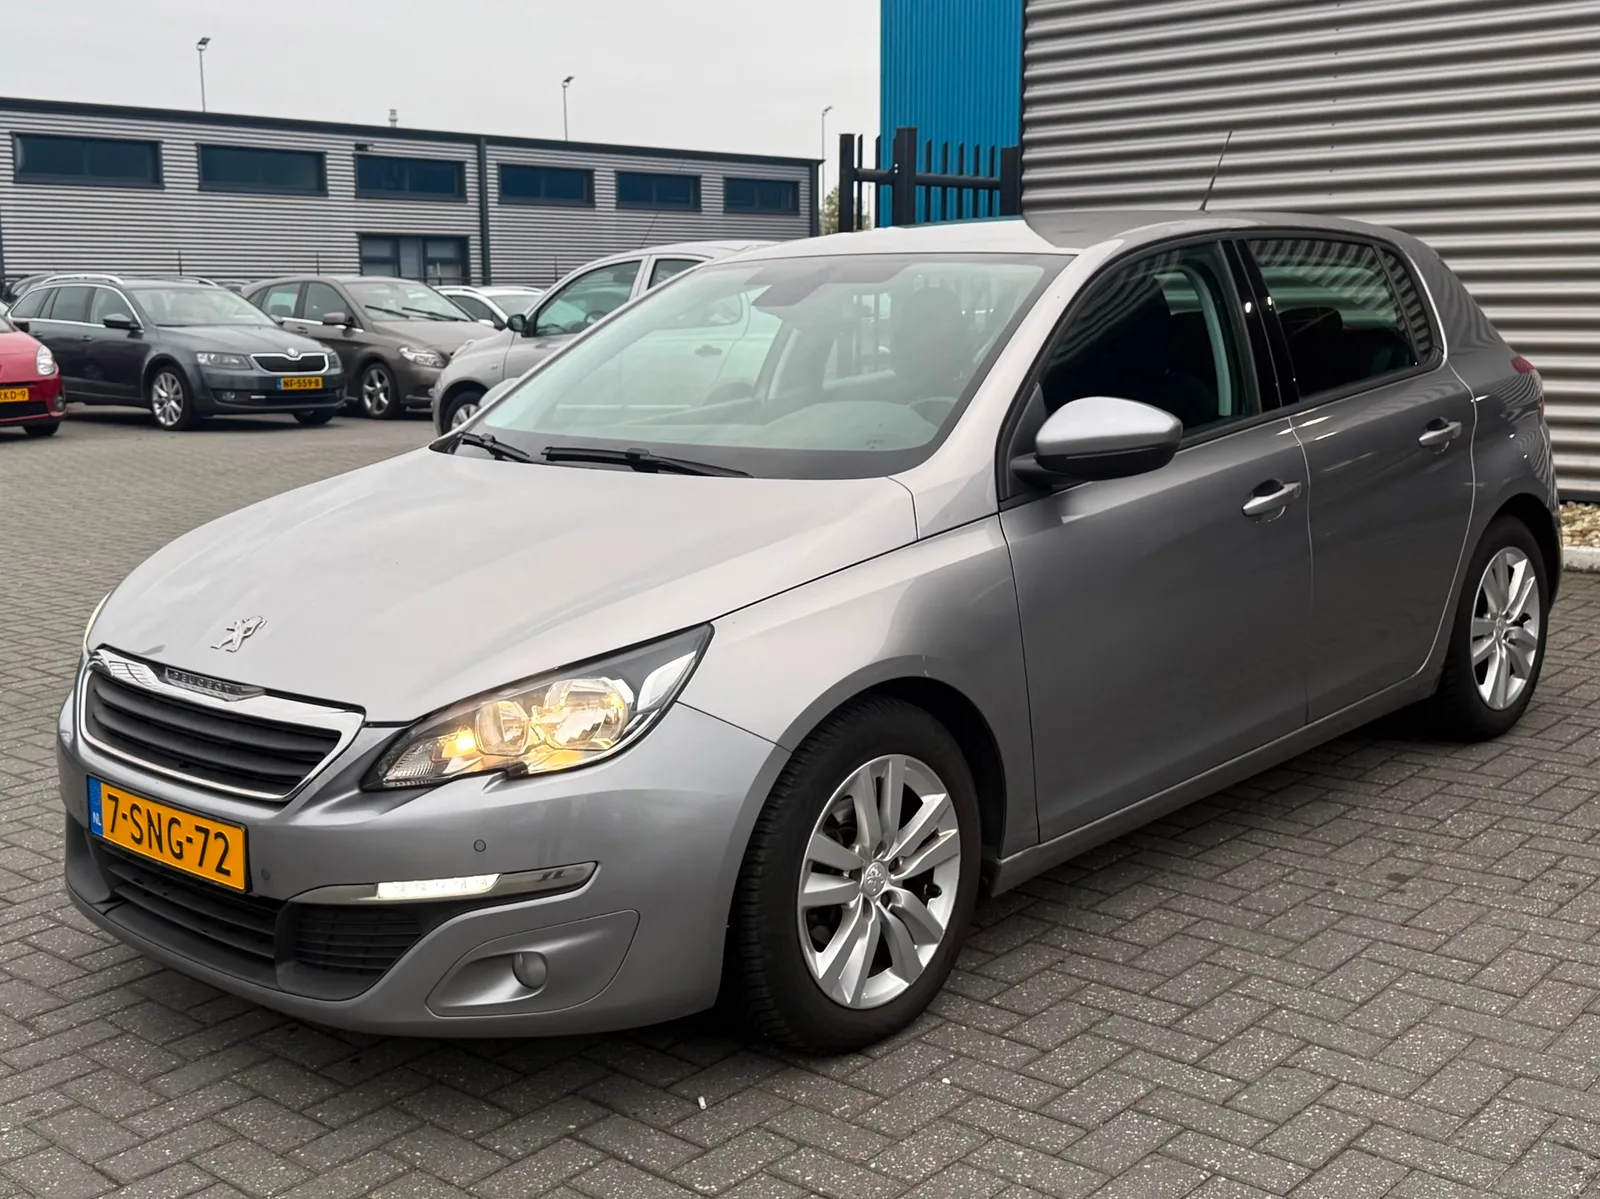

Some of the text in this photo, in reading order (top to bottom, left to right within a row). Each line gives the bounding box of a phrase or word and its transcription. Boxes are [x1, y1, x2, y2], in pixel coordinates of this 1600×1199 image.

[170, 671, 231, 693] PEUGEOT
[92, 811, 102, 826] NL
[107, 793, 231, 876] 7-SNG-72
